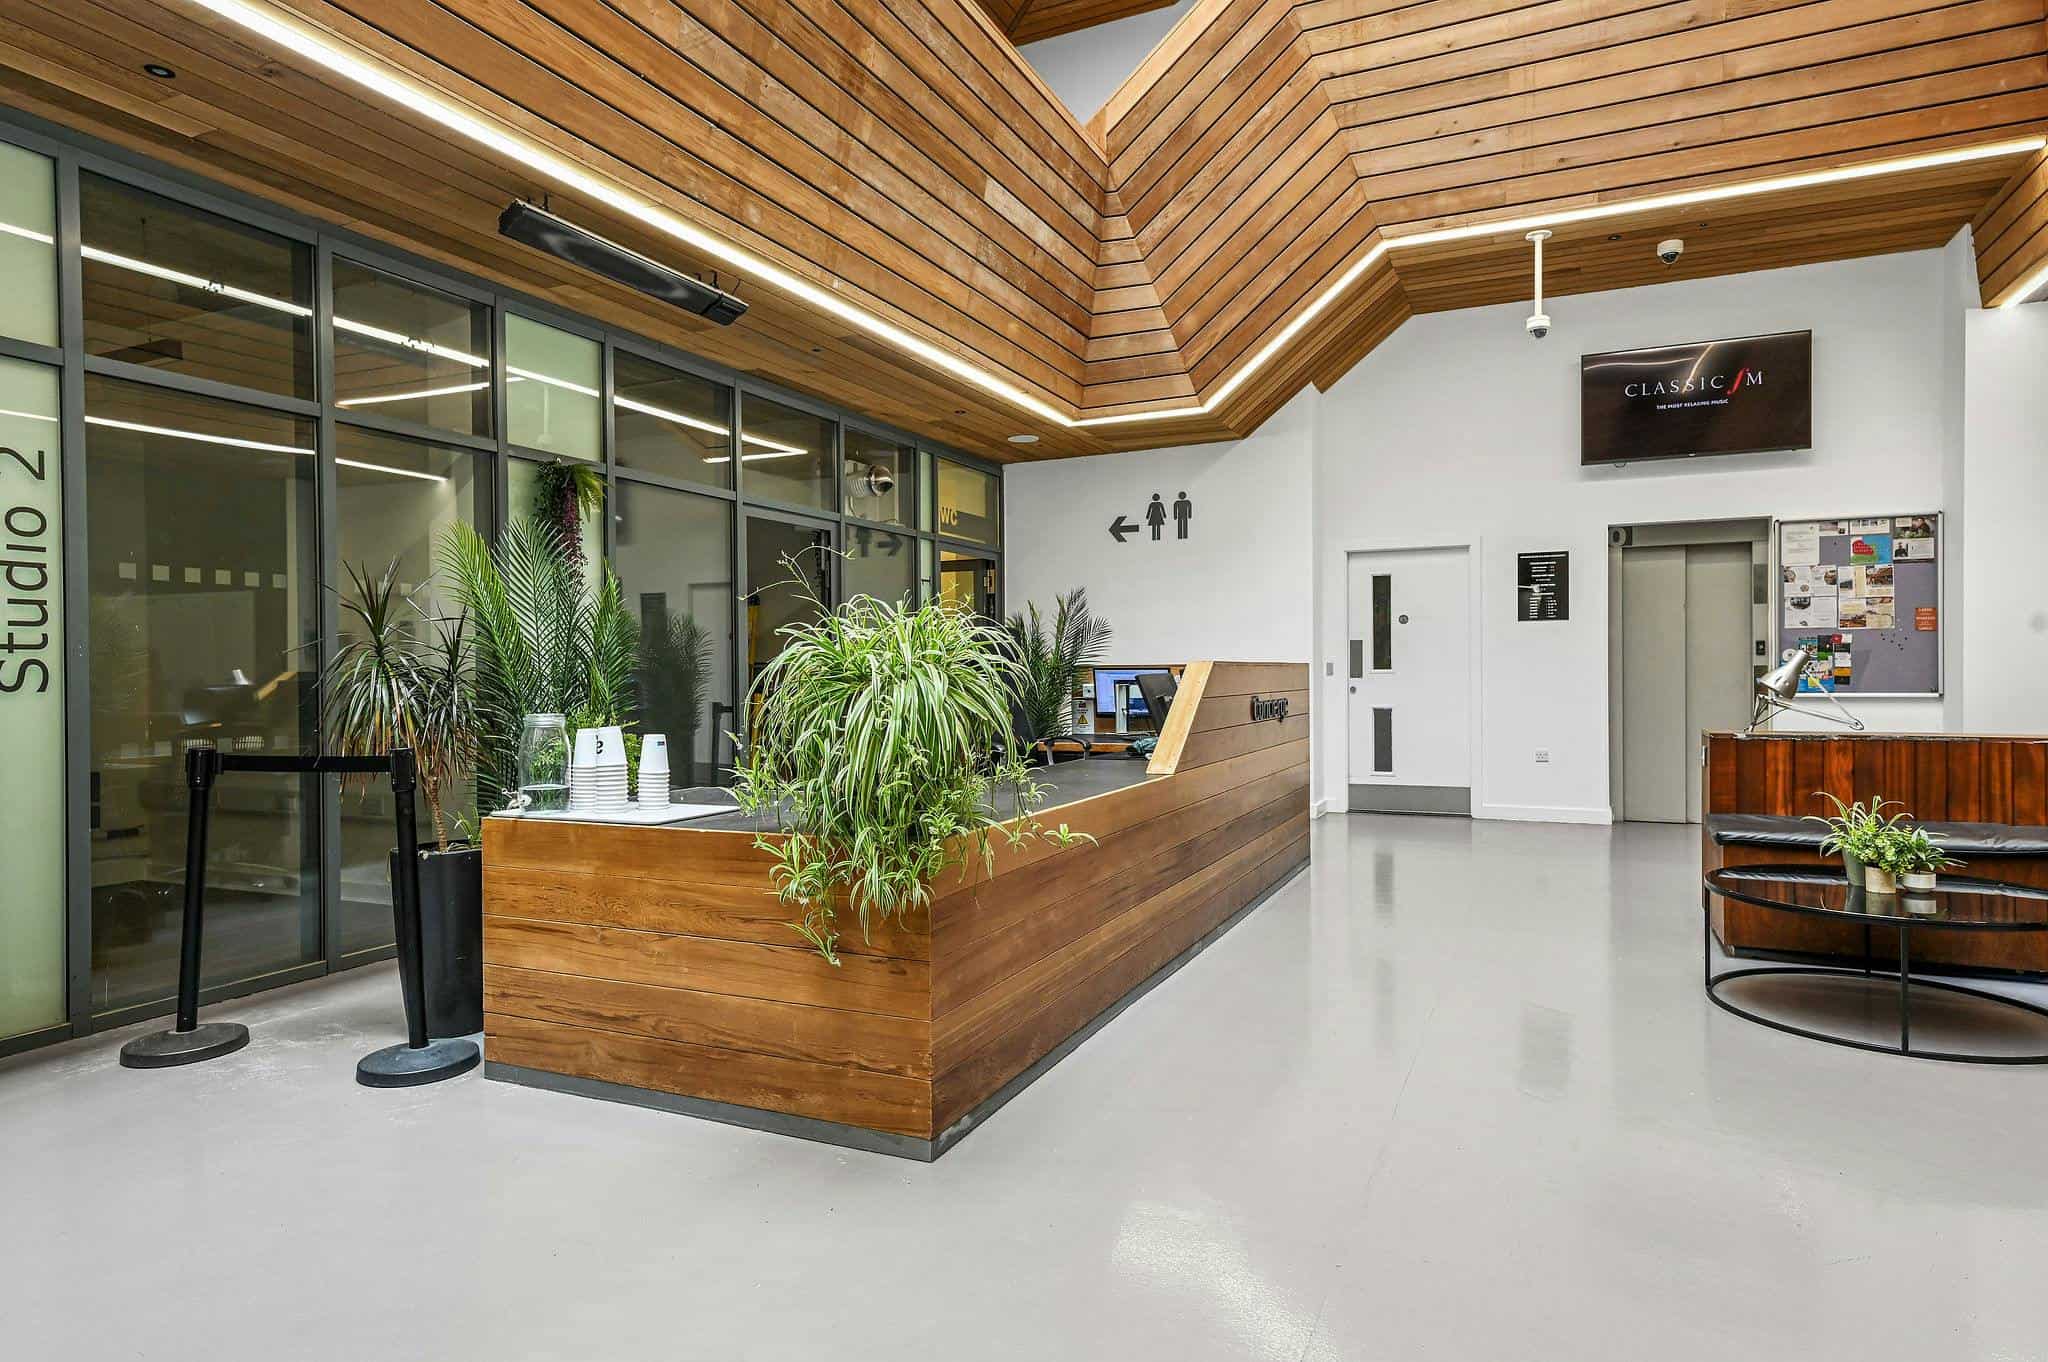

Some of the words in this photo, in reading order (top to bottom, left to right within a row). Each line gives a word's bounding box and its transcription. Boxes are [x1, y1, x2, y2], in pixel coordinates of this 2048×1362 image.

[1624, 375, 1724, 398] CLASSIC
[1711, 398, 1729, 406] MUSIC
[0, 446, 45, 481] 2
[940, 506, 958, 526] WC
[0, 506, 49, 693] Studio
